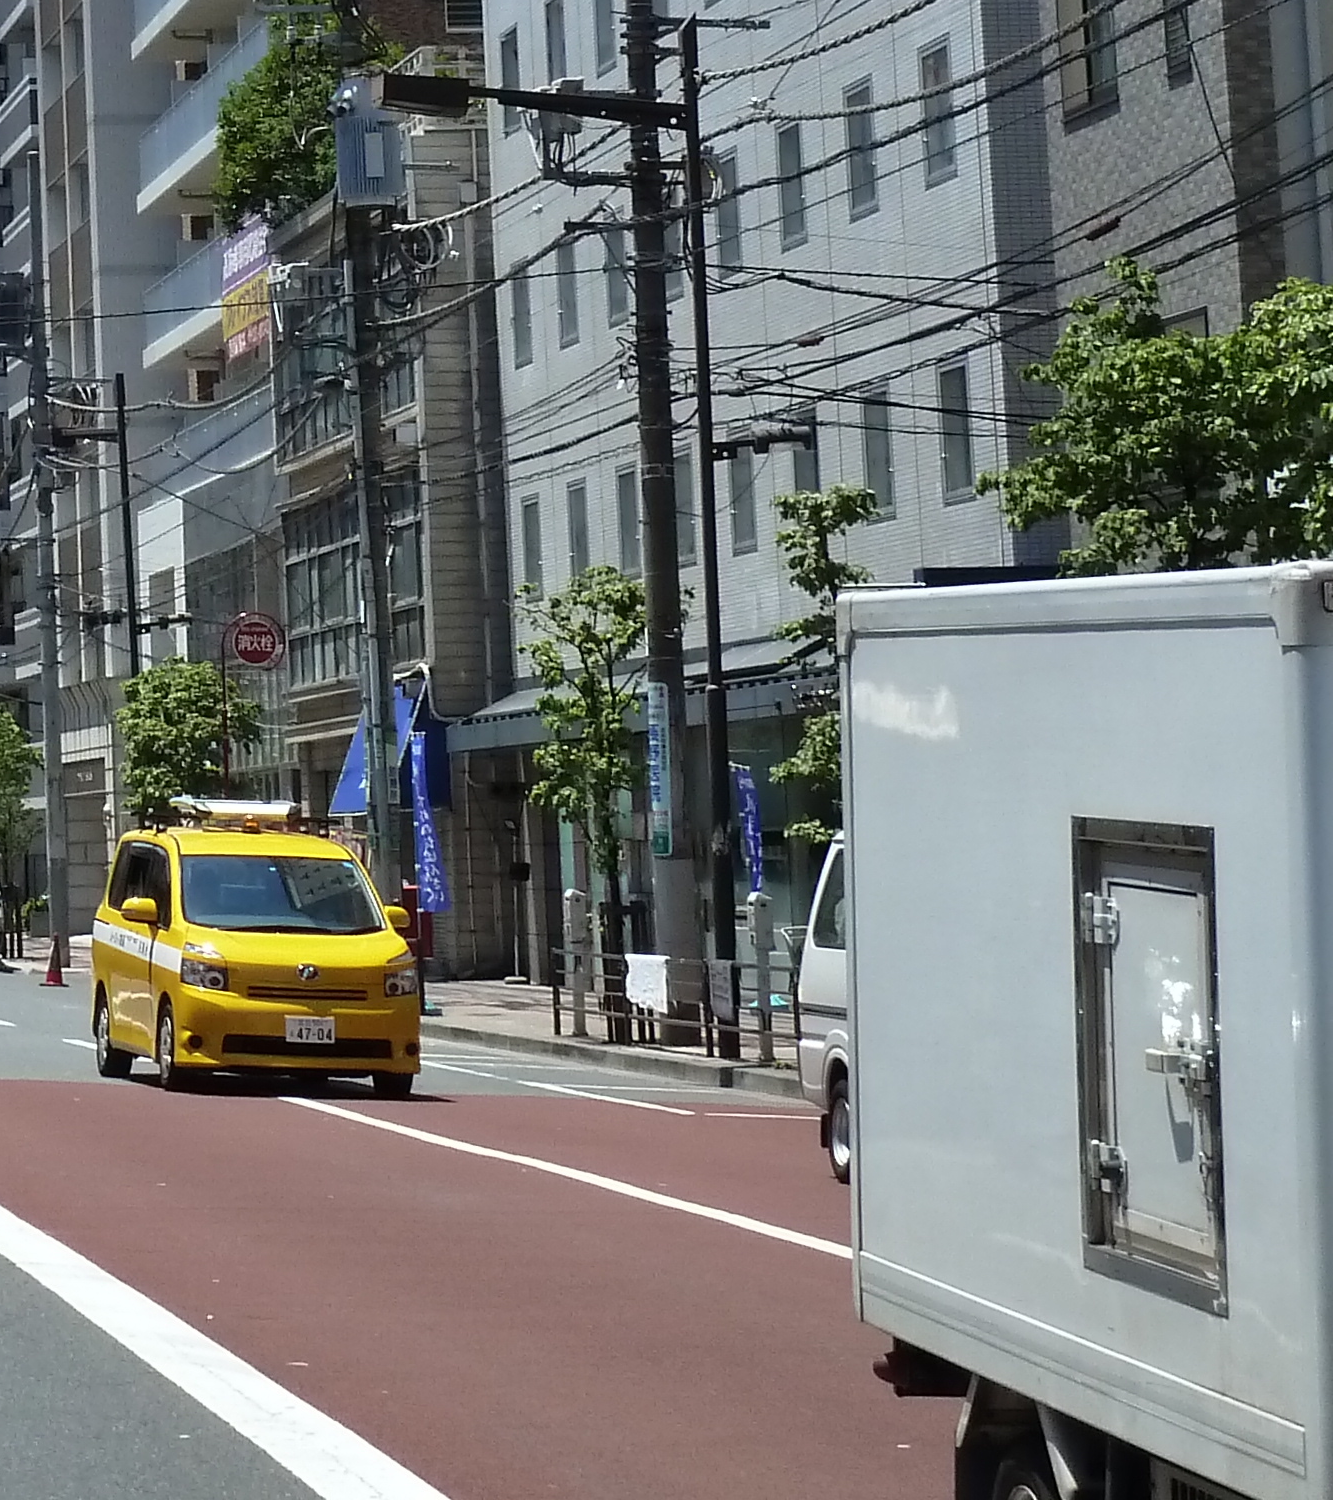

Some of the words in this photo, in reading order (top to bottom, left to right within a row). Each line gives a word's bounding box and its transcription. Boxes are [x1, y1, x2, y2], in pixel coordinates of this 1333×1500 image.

[237, 633, 273, 651] 消火栓
[297, 1027, 332, 1041] 47-04
